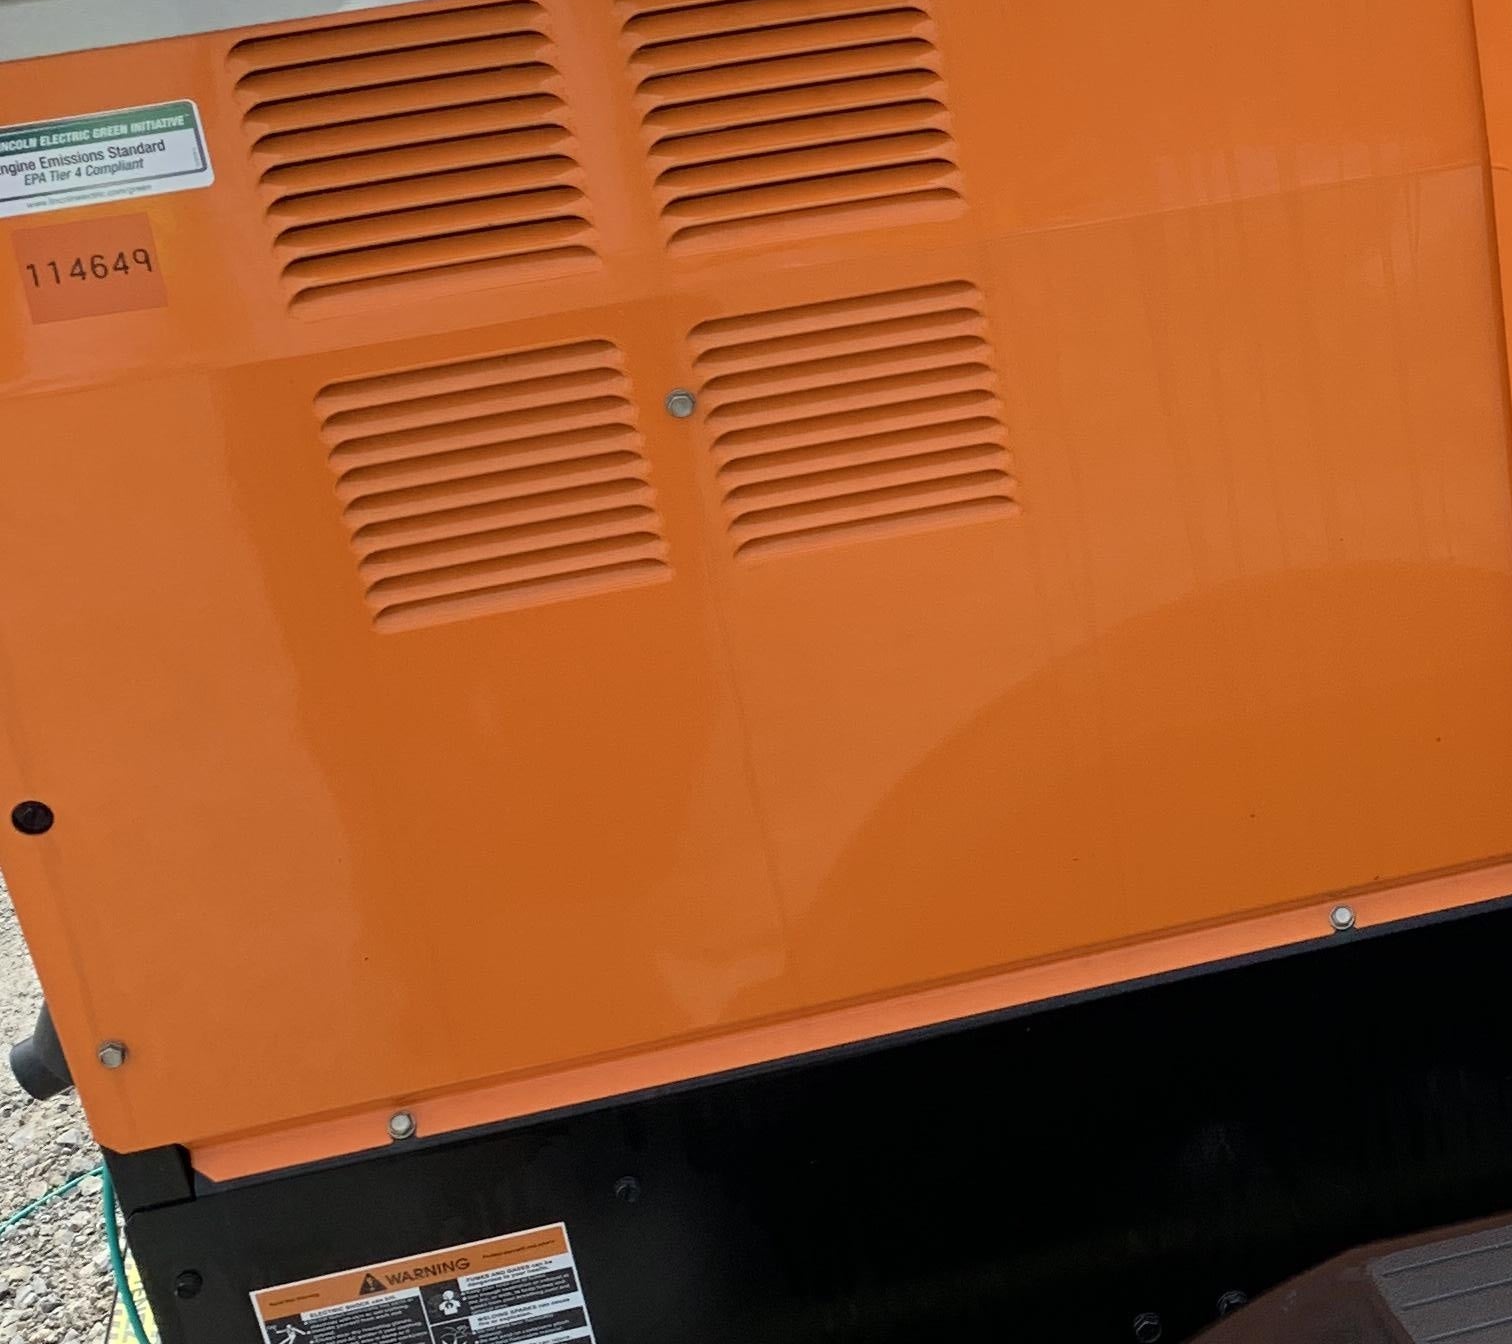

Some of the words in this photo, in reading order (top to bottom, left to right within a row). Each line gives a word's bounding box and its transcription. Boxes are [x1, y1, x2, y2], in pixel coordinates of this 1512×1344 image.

[39, 127, 91, 147] ELECTRIC
[92, 123, 129, 140] GREEN
[0, 159, 37, 176] ngine
[38, 146, 105, 170] Emissions
[107, 138, 166, 159] Standard
[23, 171, 48, 187] EPA
[49, 167, 72, 183] Tier
[74, 166, 83, 178] 4
[84, 157, 145, 178] Compliant
[26, 247, 153, 289] 114649
[384, 1256, 471, 1286] WARNING
